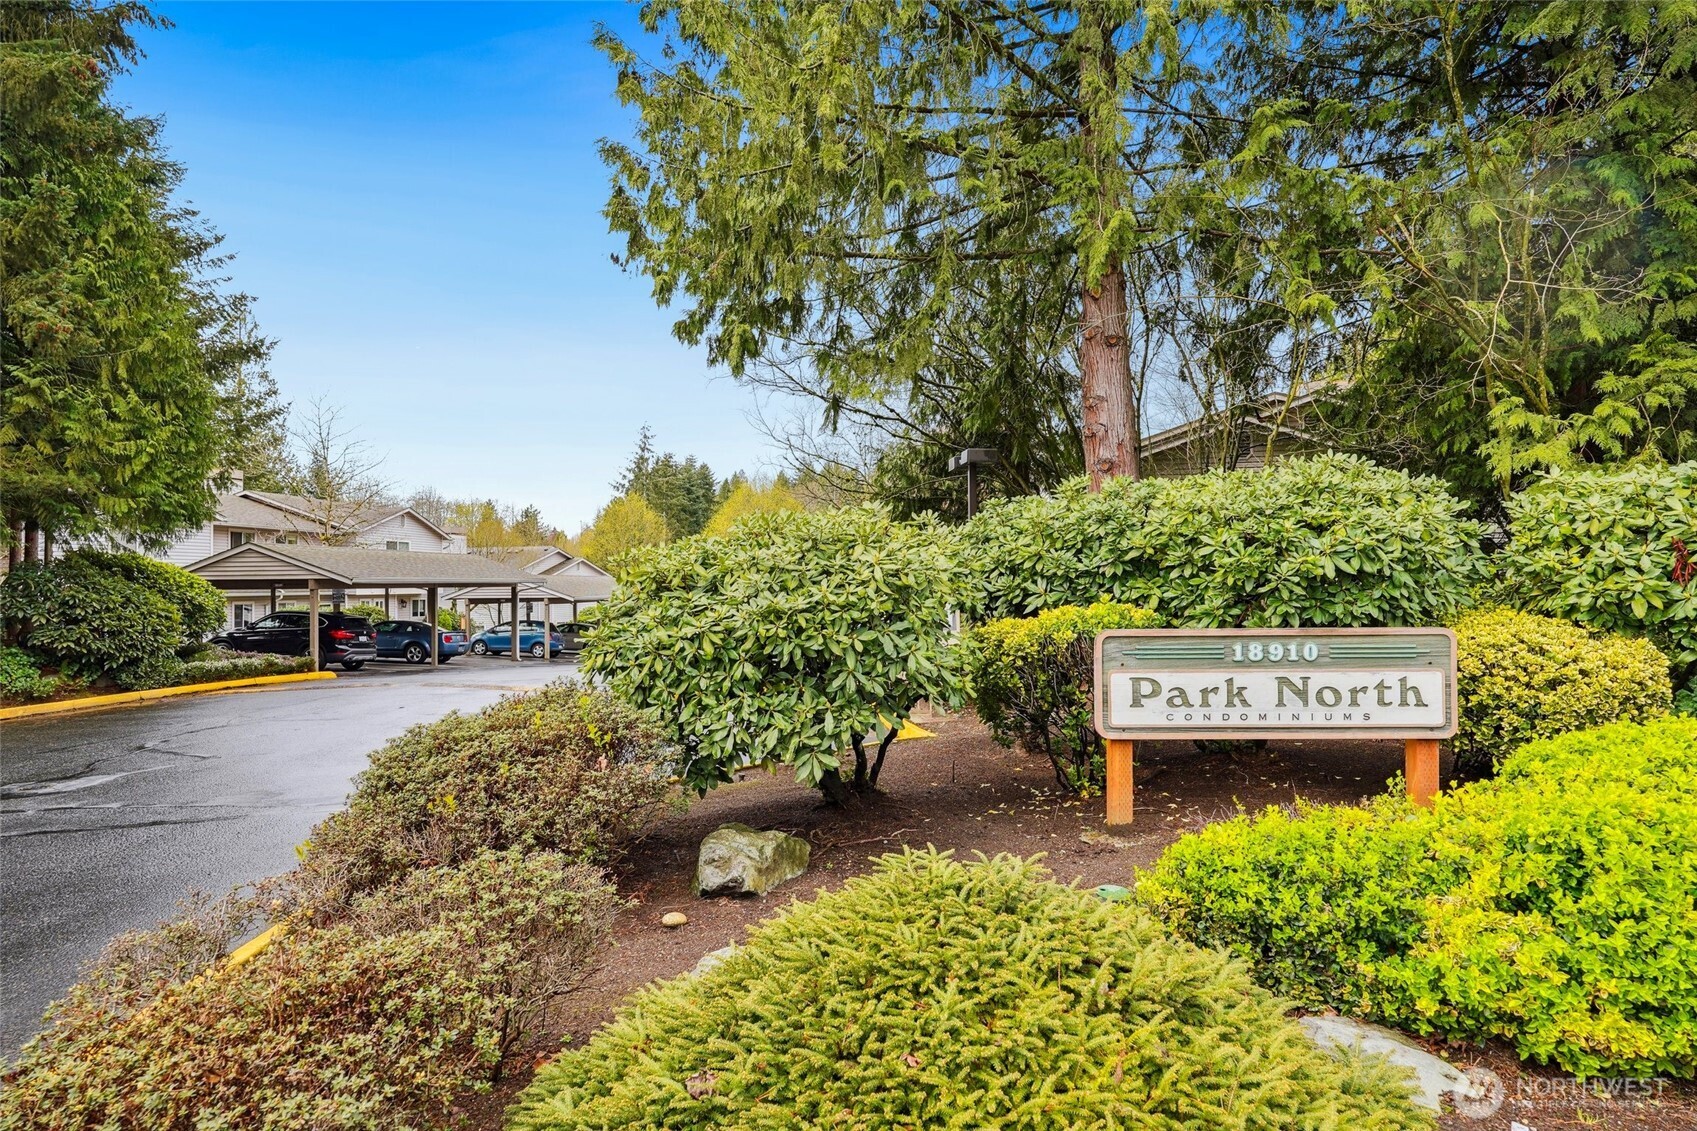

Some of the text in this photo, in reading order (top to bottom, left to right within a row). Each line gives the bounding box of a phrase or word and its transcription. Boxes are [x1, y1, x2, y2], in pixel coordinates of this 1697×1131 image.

[1232, 641, 1319, 662] 18910
[1129, 675, 1428, 708] Park North
[1166, 713, 1371, 721] CONDOMINIUMS
